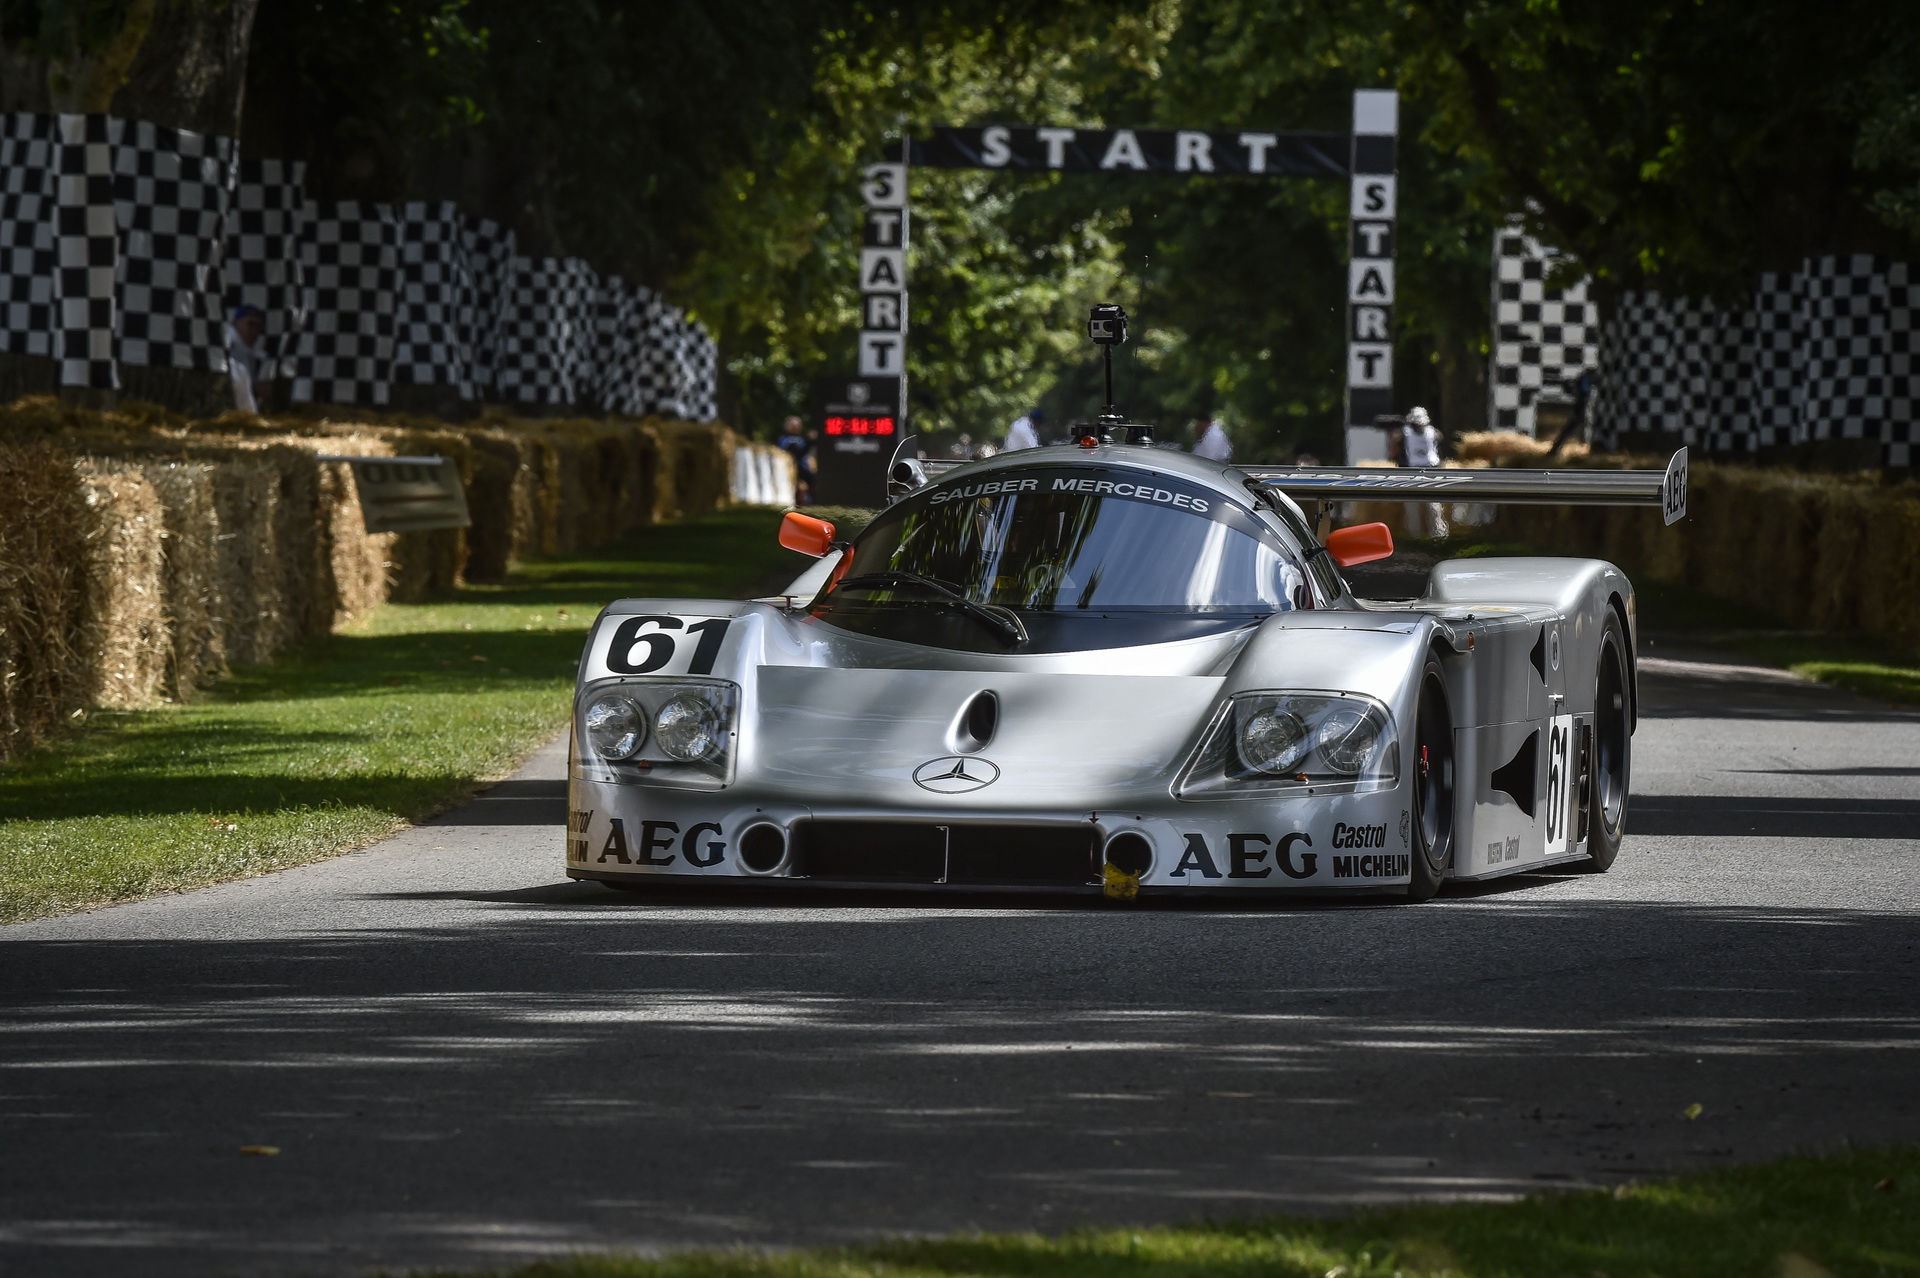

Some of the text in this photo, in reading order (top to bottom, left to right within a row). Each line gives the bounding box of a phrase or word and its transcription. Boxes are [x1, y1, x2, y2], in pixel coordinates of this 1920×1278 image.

[980, 127, 1278, 173] START
[869, 170, 900, 369] START
[1356, 183, 1390, 379] START
[929, 478, 1209, 513] SAUBER MERCEDES
[1666, 466, 1686, 517] AEG
[606, 615, 732, 675] 61
[1546, 724, 1568, 844] 61
[597, 818, 727, 867] AEG
[1170, 832, 1318, 879] AEG
[1331, 822, 1388, 849] Castrol
[1332, 854, 1409, 878] MICHELIN
